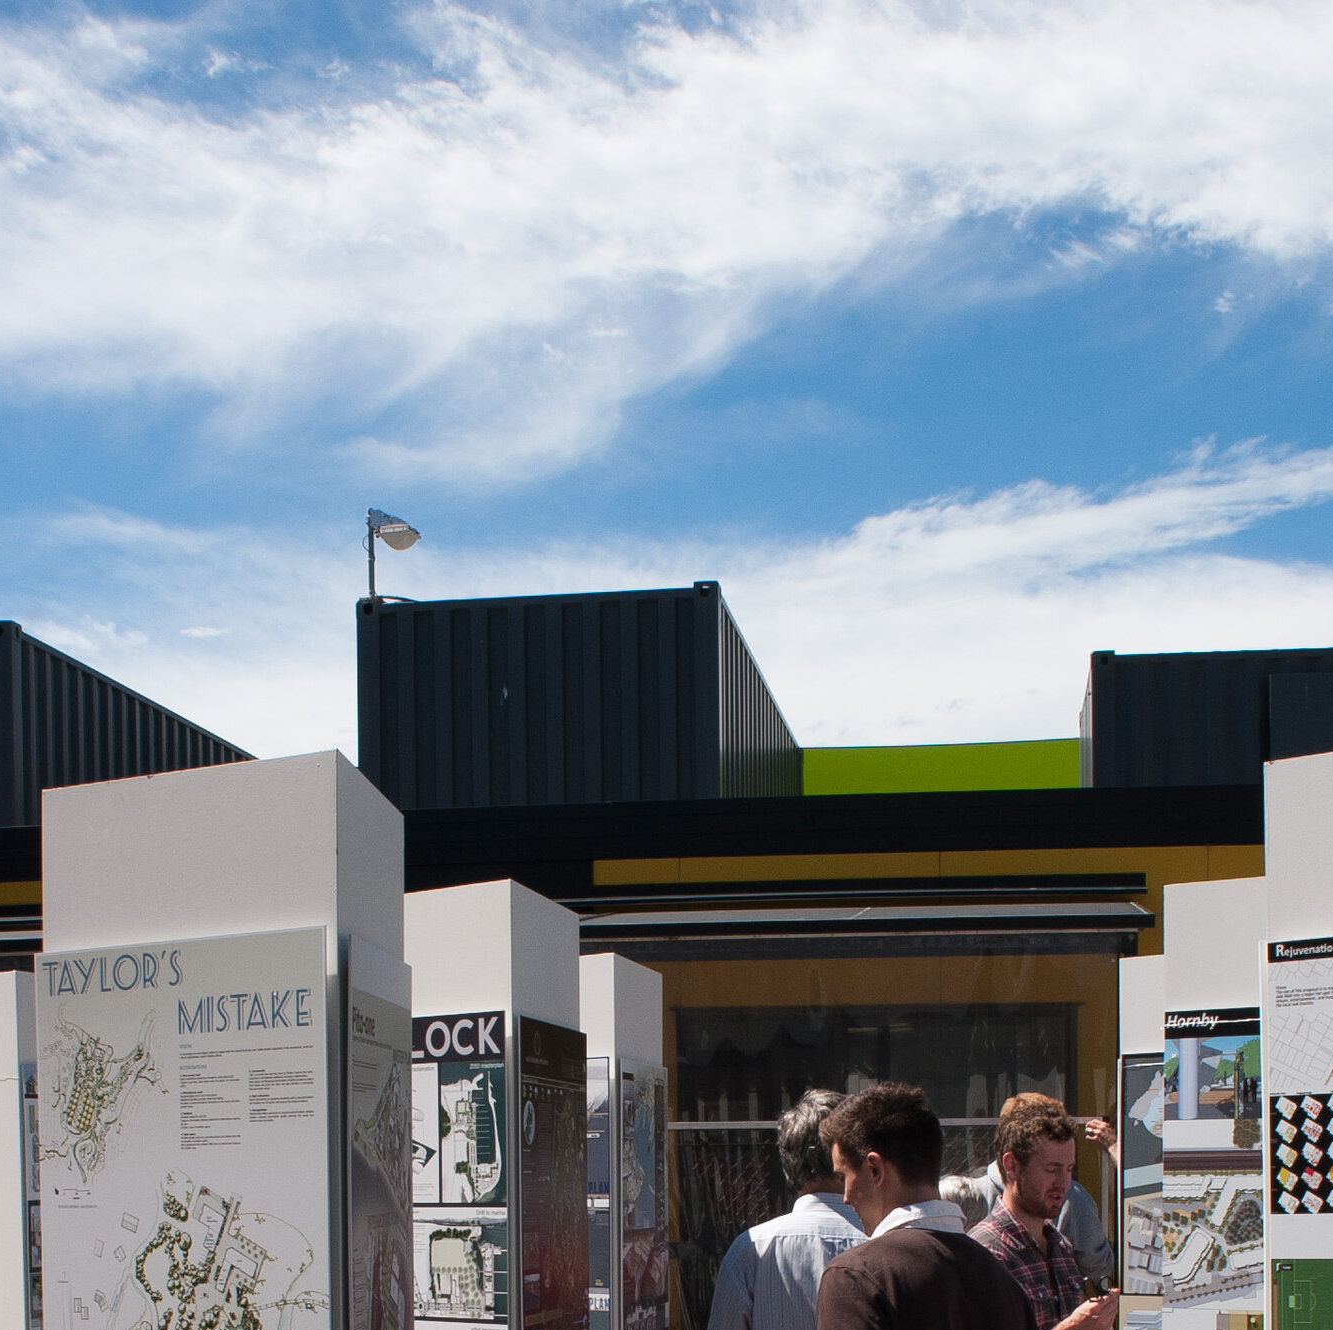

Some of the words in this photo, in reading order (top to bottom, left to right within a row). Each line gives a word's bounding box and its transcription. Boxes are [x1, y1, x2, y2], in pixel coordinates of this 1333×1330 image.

[42, 950, 183, 998] TAYLOR'S
[178, 988, 312, 1036] MISTAKE
[1167, 1012, 1219, 1031] Hornby
[588, 1297, 610, 1310] PLAN
